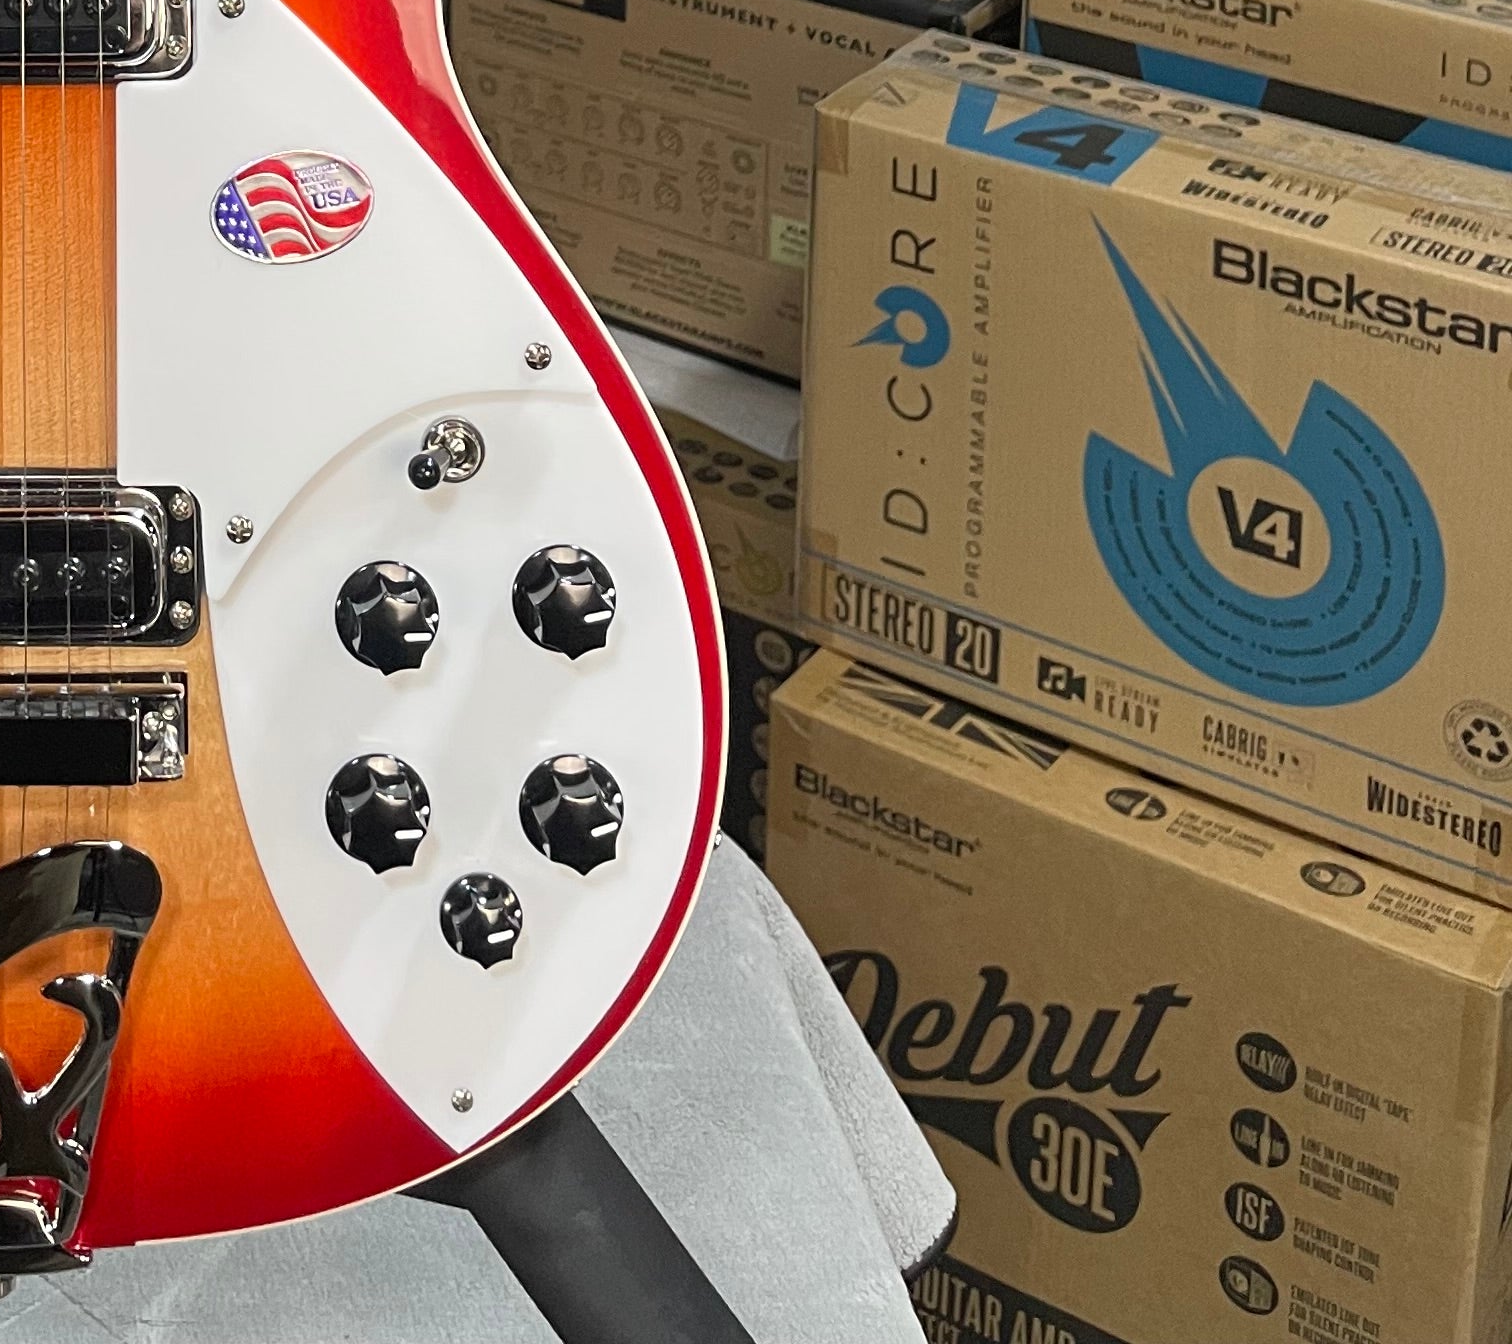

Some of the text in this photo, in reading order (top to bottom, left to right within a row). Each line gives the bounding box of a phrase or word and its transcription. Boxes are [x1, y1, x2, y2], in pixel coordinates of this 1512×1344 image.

[805, 23, 877, 59] VOCAL
[294, 161, 361, 210] PROUDLY MADE IN THE USA
[1382, 230, 1476, 267] STEREO
[1212, 237, 1512, 354] Blackstar
[1284, 301, 1443, 356] AMPLIFICATION
[962, 175, 994, 600] PROGRAMMABLE AMPLIFIER
[1216, 485, 1304, 571] V4
[833, 574, 992, 679] STEREO 20
[1094, 689, 1160, 735] READY
[1202, 714, 1267, 762] CABRIG
[794, 762, 976, 859] Blackstar
[1366, 775, 1503, 858] WIDESTEREO
[1029, 1112, 1120, 1222] 30E
[1236, 1187, 1274, 1234] ISF
[912, 1265, 1003, 1344] UITAR
